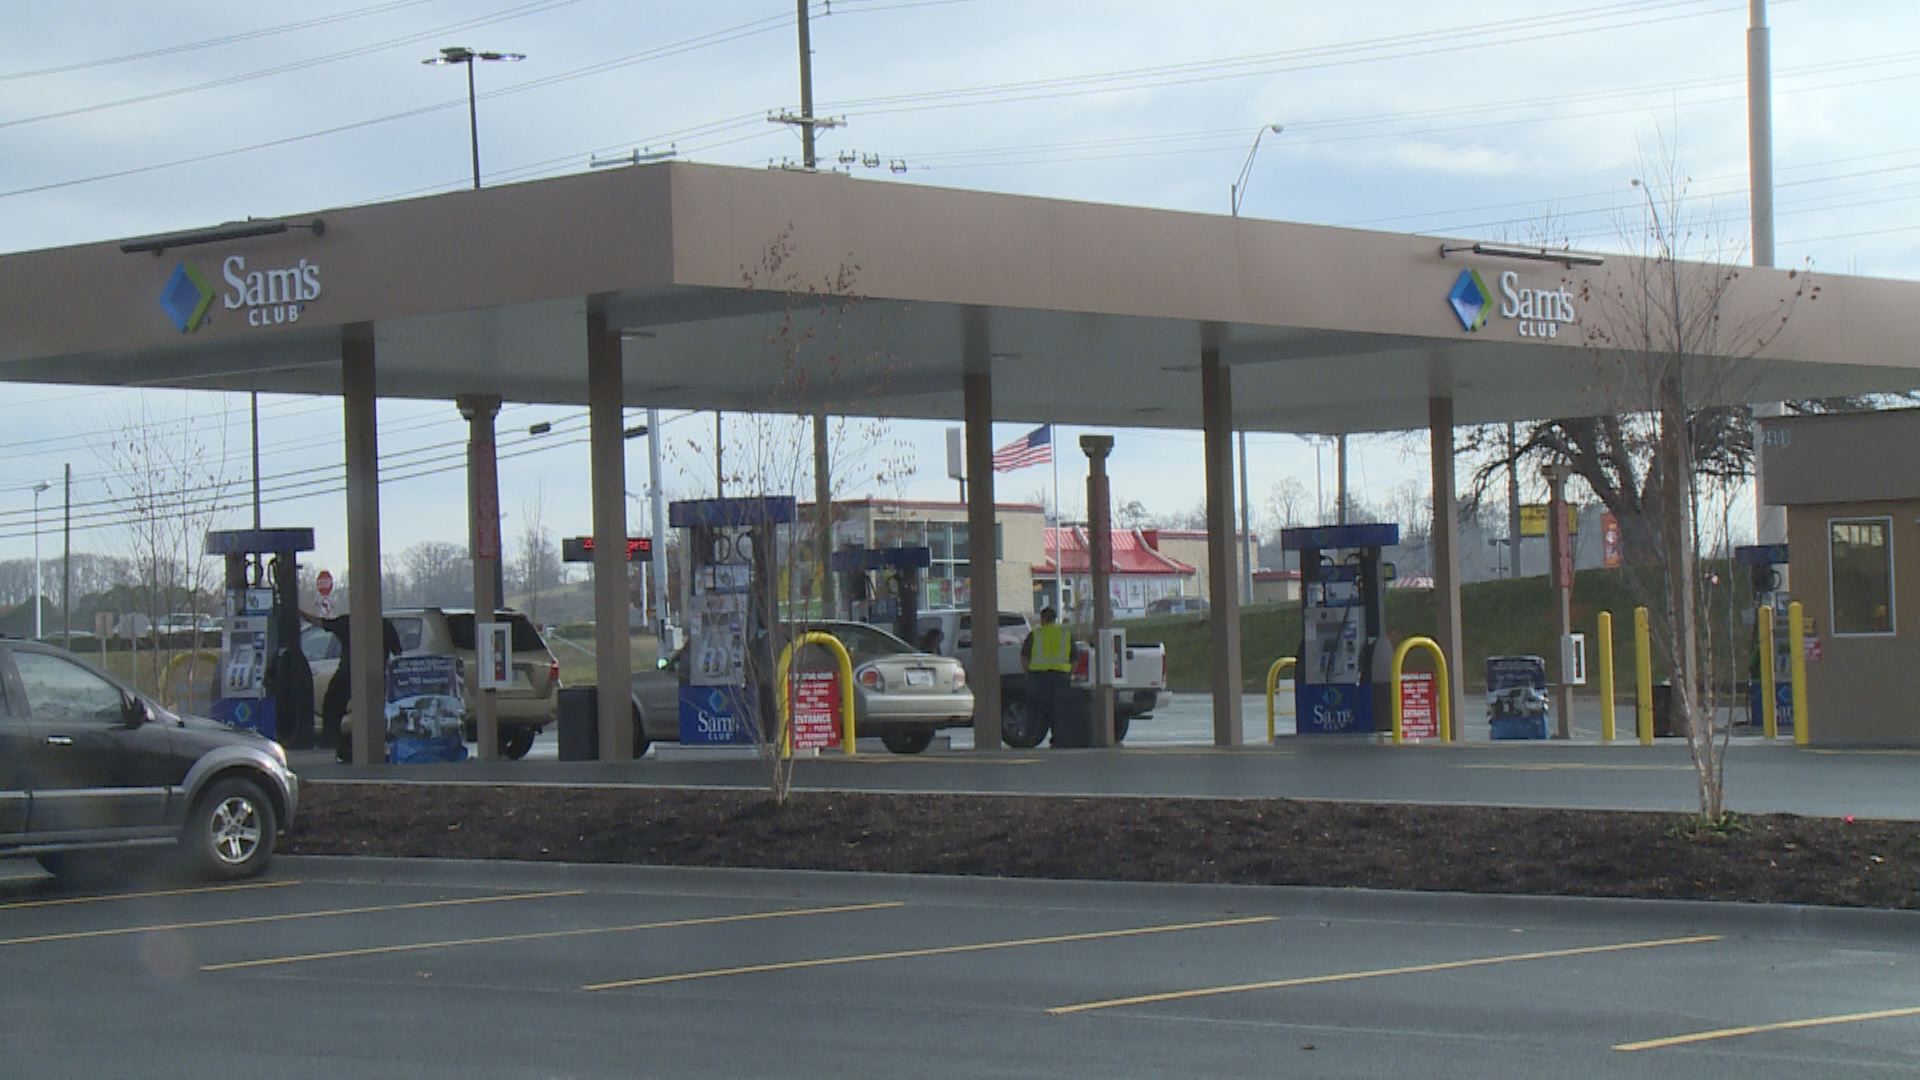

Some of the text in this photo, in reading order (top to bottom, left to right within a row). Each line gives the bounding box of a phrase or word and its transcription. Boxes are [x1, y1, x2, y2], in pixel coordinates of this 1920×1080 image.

[223, 255, 321, 309] Sam's
[1501, 271, 1575, 323] Sam's
[248, 304, 300, 327] CLUB
[1519, 321, 1557, 338] CLUB
[708, 732, 731, 741] CLUB
